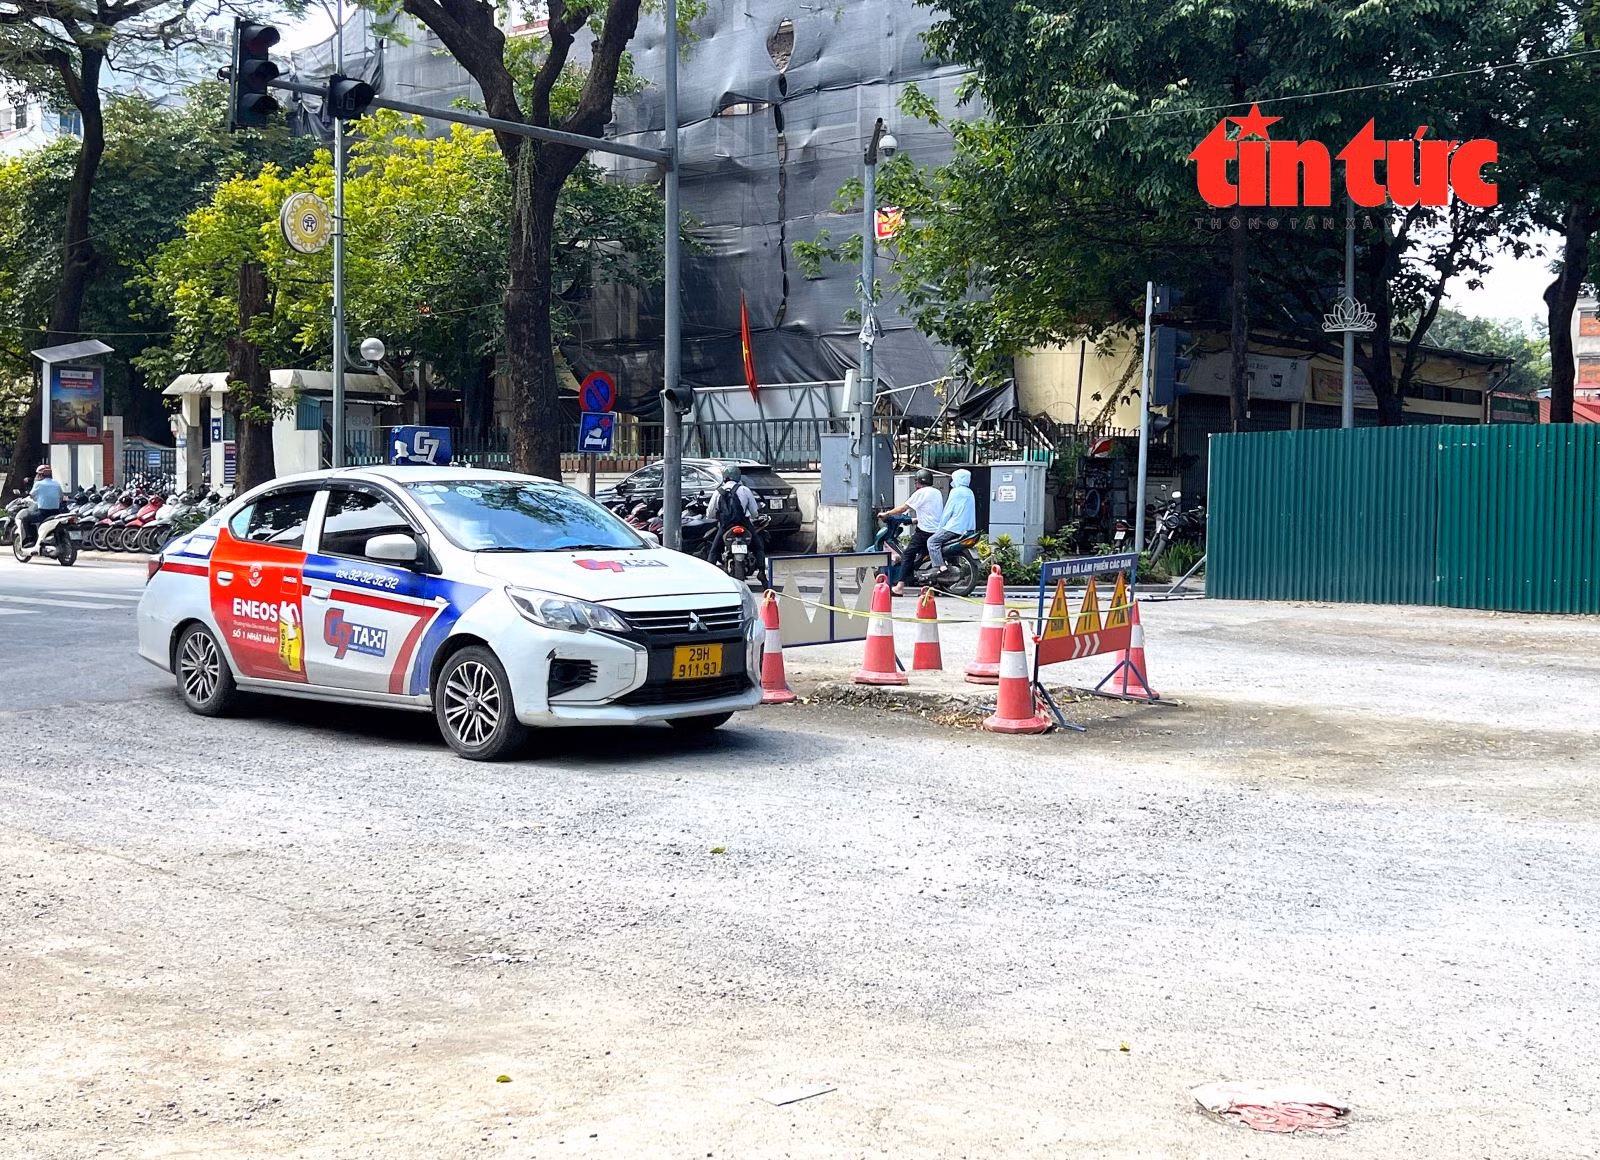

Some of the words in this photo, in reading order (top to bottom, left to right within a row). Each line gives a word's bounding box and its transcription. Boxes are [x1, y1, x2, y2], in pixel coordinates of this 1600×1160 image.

[414, 431, 440, 463] G7
[1051, 567, 1062, 576] XIN
[232, 597, 278, 622] ENEOS
[352, 625, 386, 650] TAXI
[688, 647, 710, 662] 29H
[678, 661, 717, 678] 911.93
